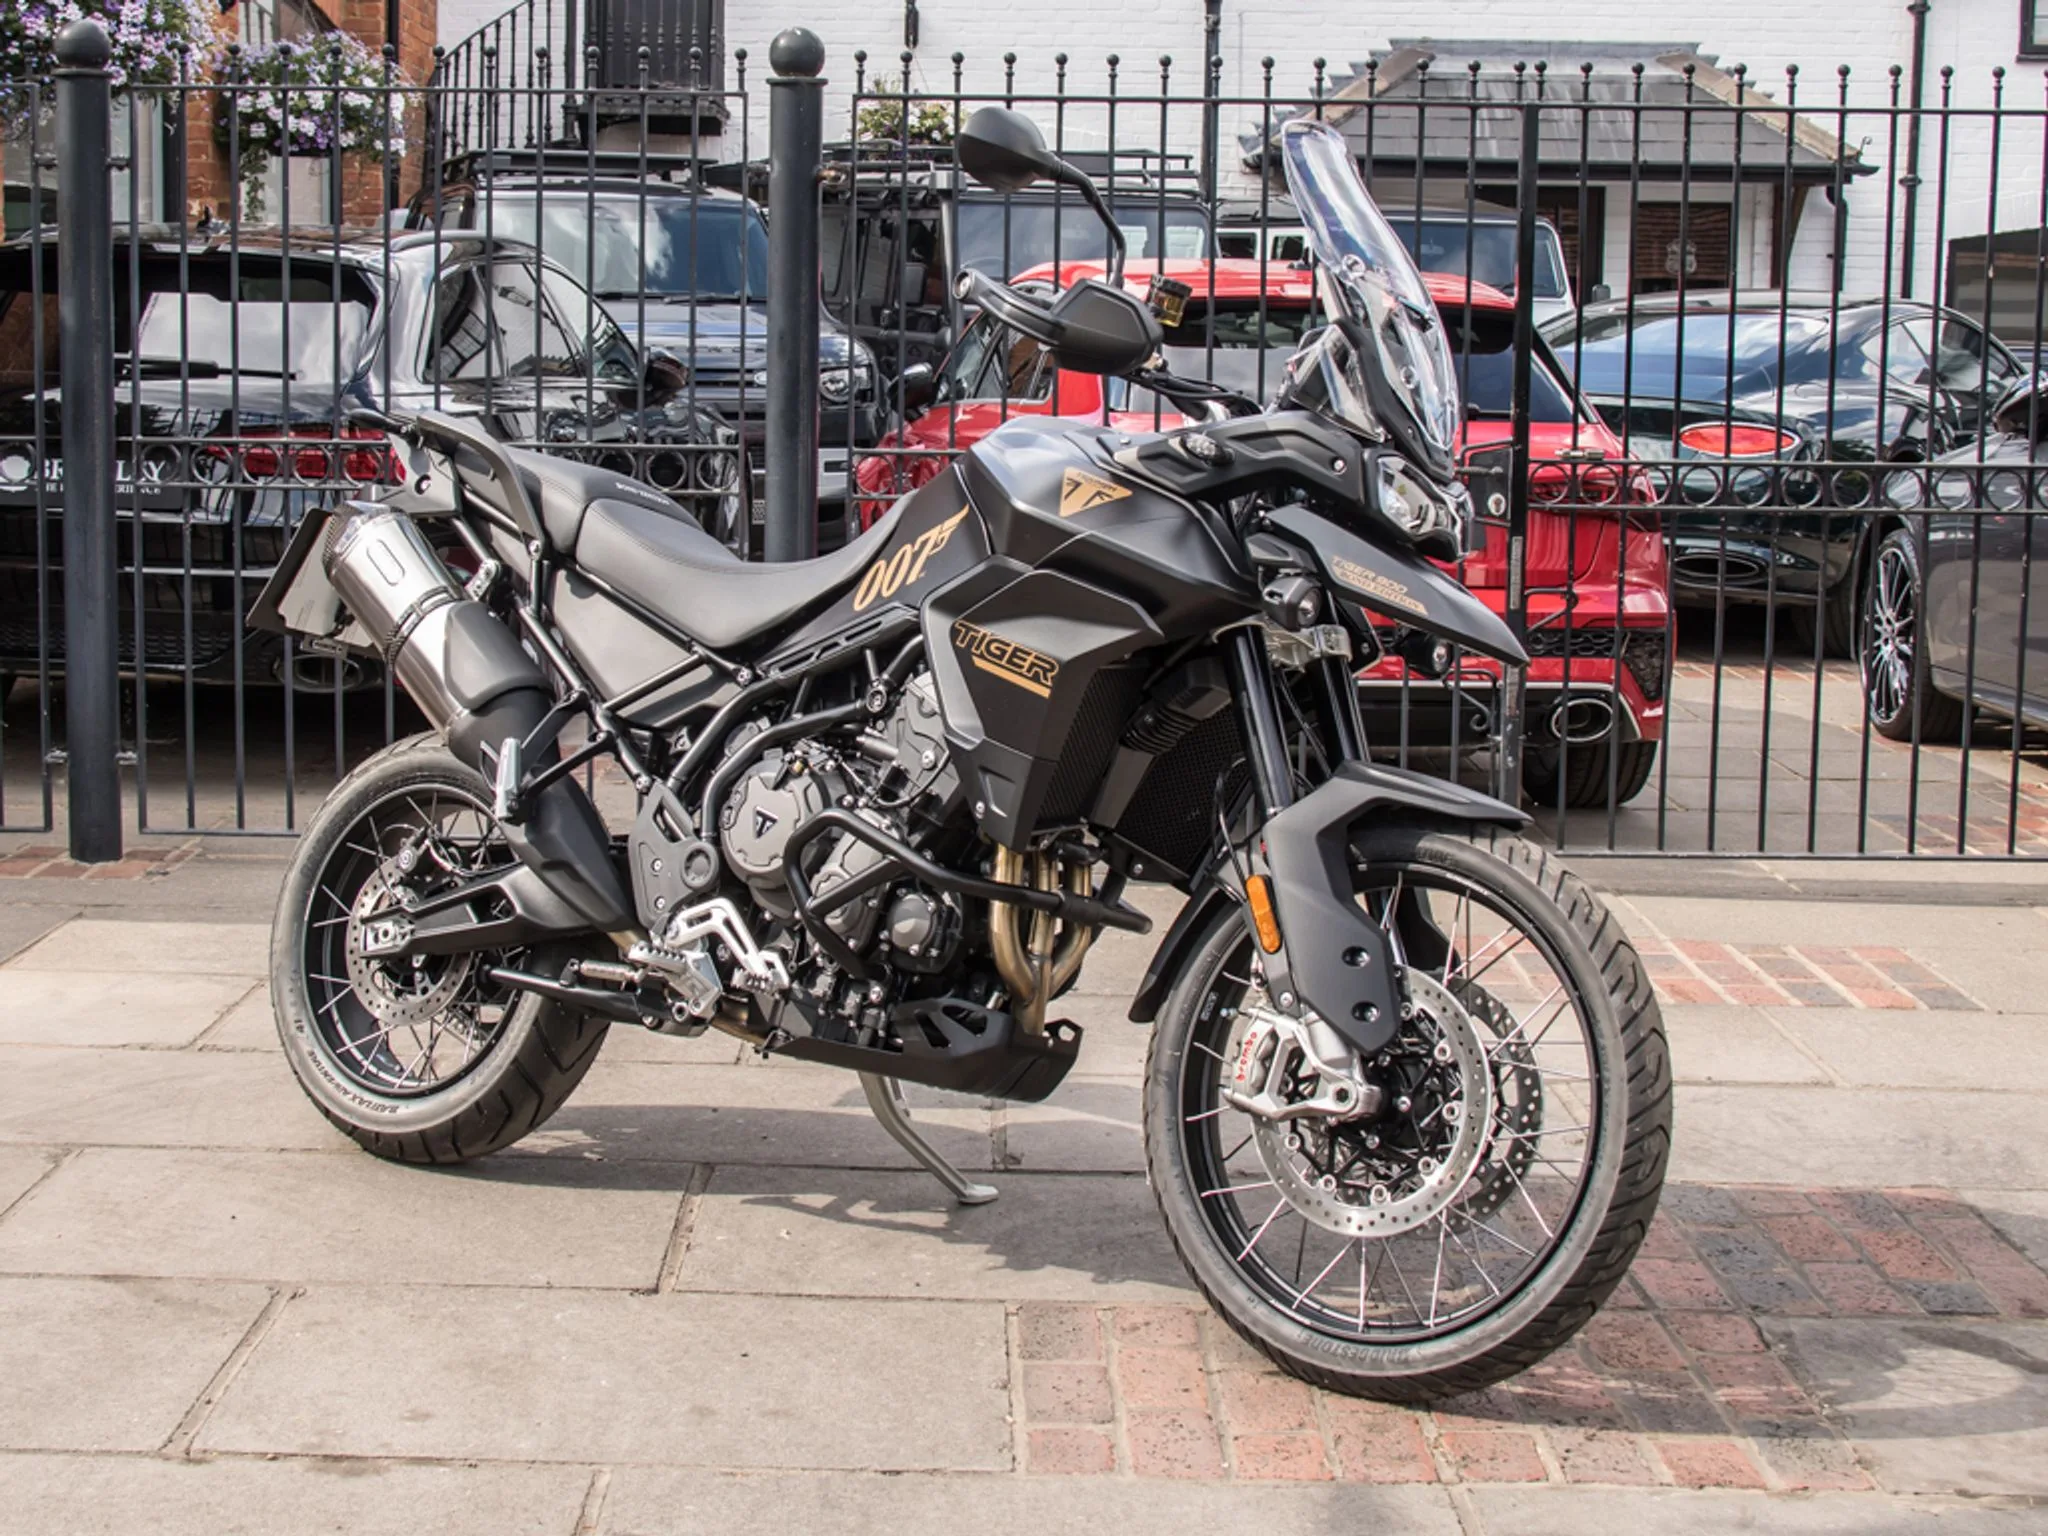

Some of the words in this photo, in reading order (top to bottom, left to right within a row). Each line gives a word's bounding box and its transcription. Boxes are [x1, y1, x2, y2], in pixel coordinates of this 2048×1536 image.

[853, 503, 969, 611] 007
[954, 619, 1060, 687] TIGER
[1236, 1032, 1258, 1081] brembo
